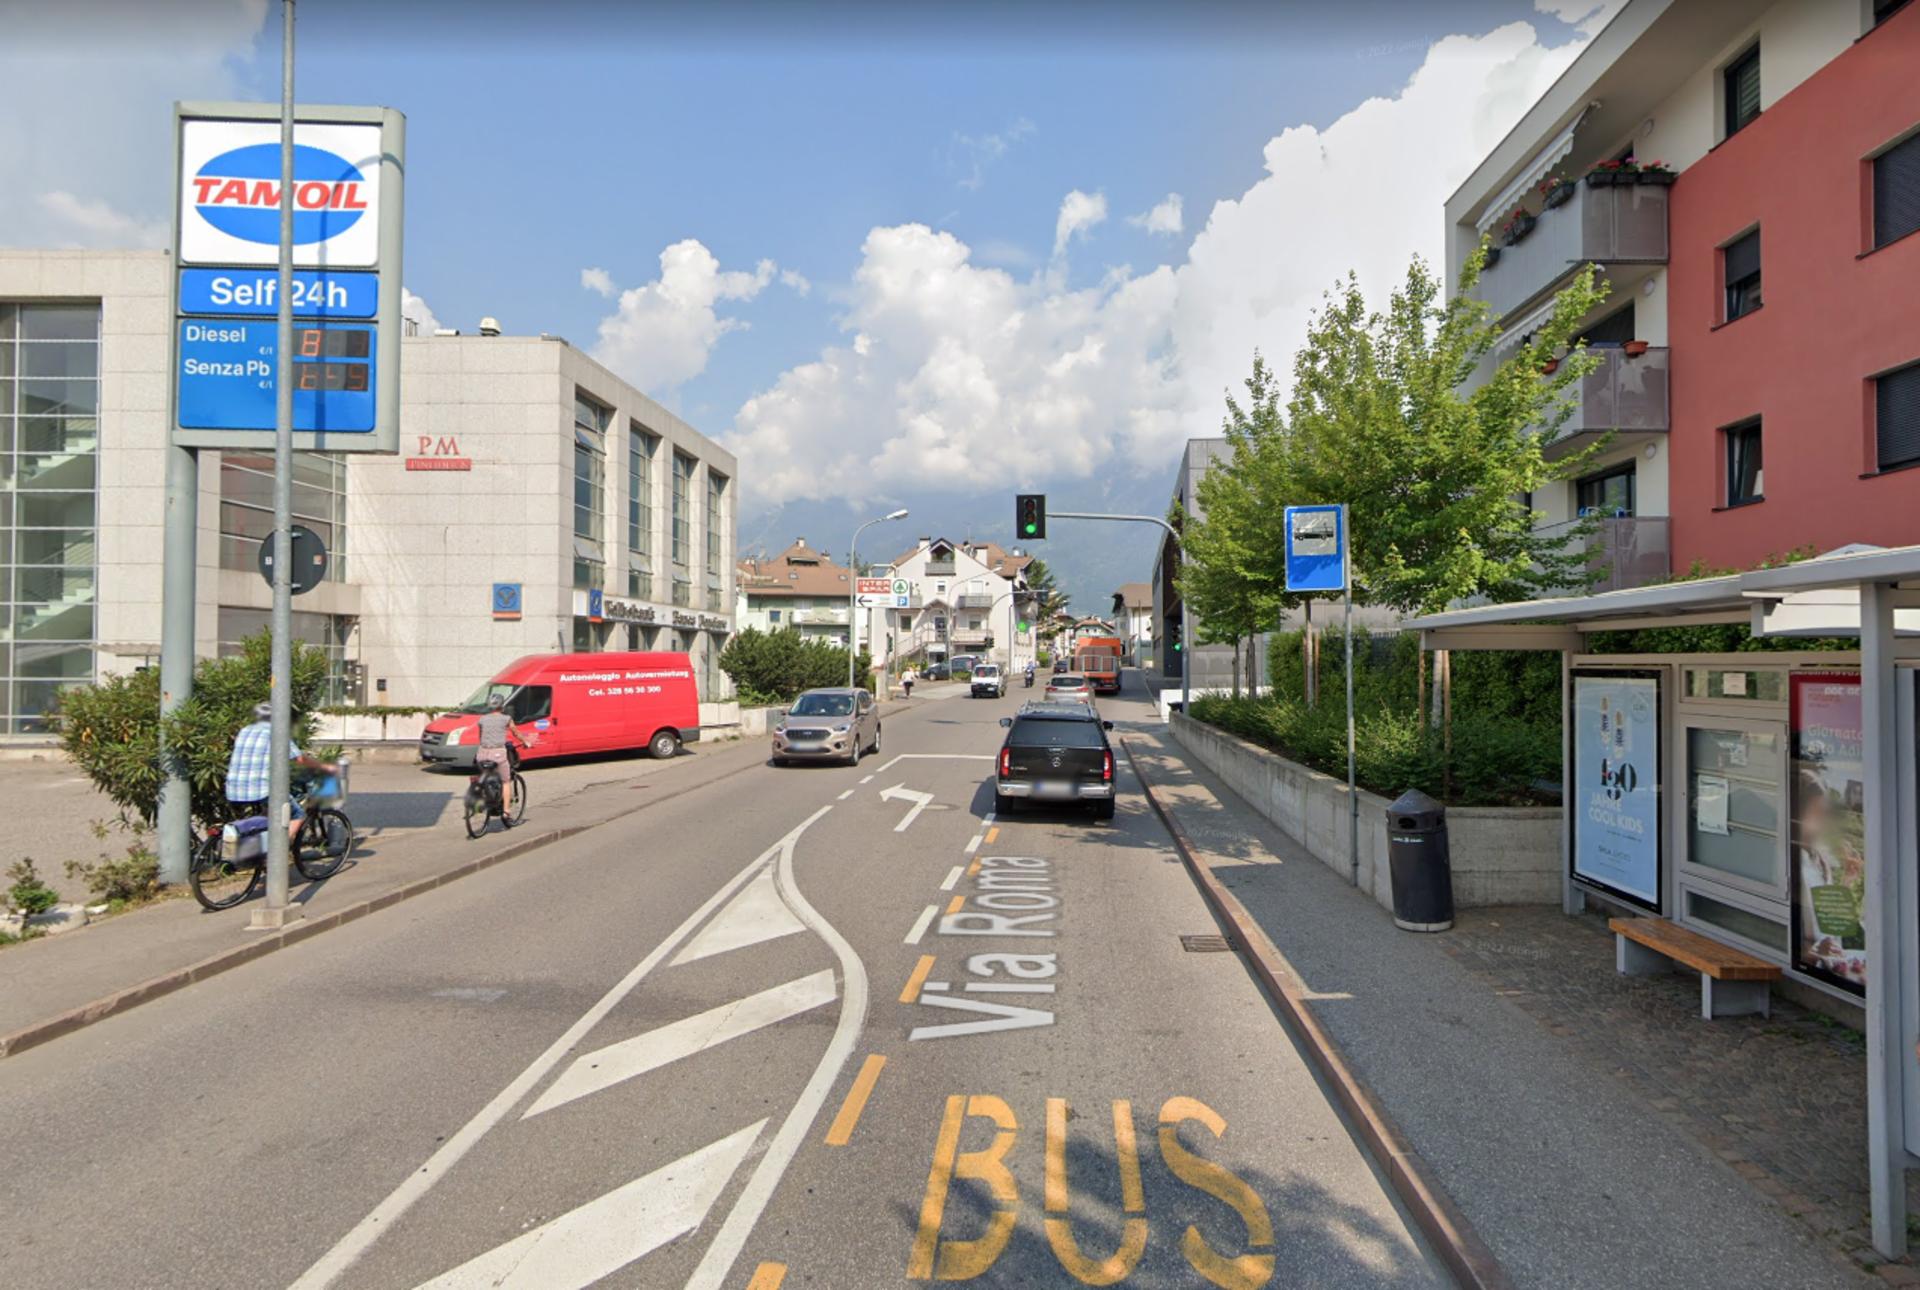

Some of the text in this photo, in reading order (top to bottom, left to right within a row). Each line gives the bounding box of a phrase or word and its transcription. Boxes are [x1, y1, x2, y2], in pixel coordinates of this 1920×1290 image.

[193, 177, 368, 210] TAMOIL
[211, 277, 347, 308] Self 24h
[186, 325, 246, 343] Diesel
[184, 359, 270, 378] Senza Pb
[417, 435, 460, 455] PM
[560, 671, 621, 683] Autonoleggio
[1588, 807, 1644, 835] COOL KIDS
[906, 1094, 1276, 1290] BUS
